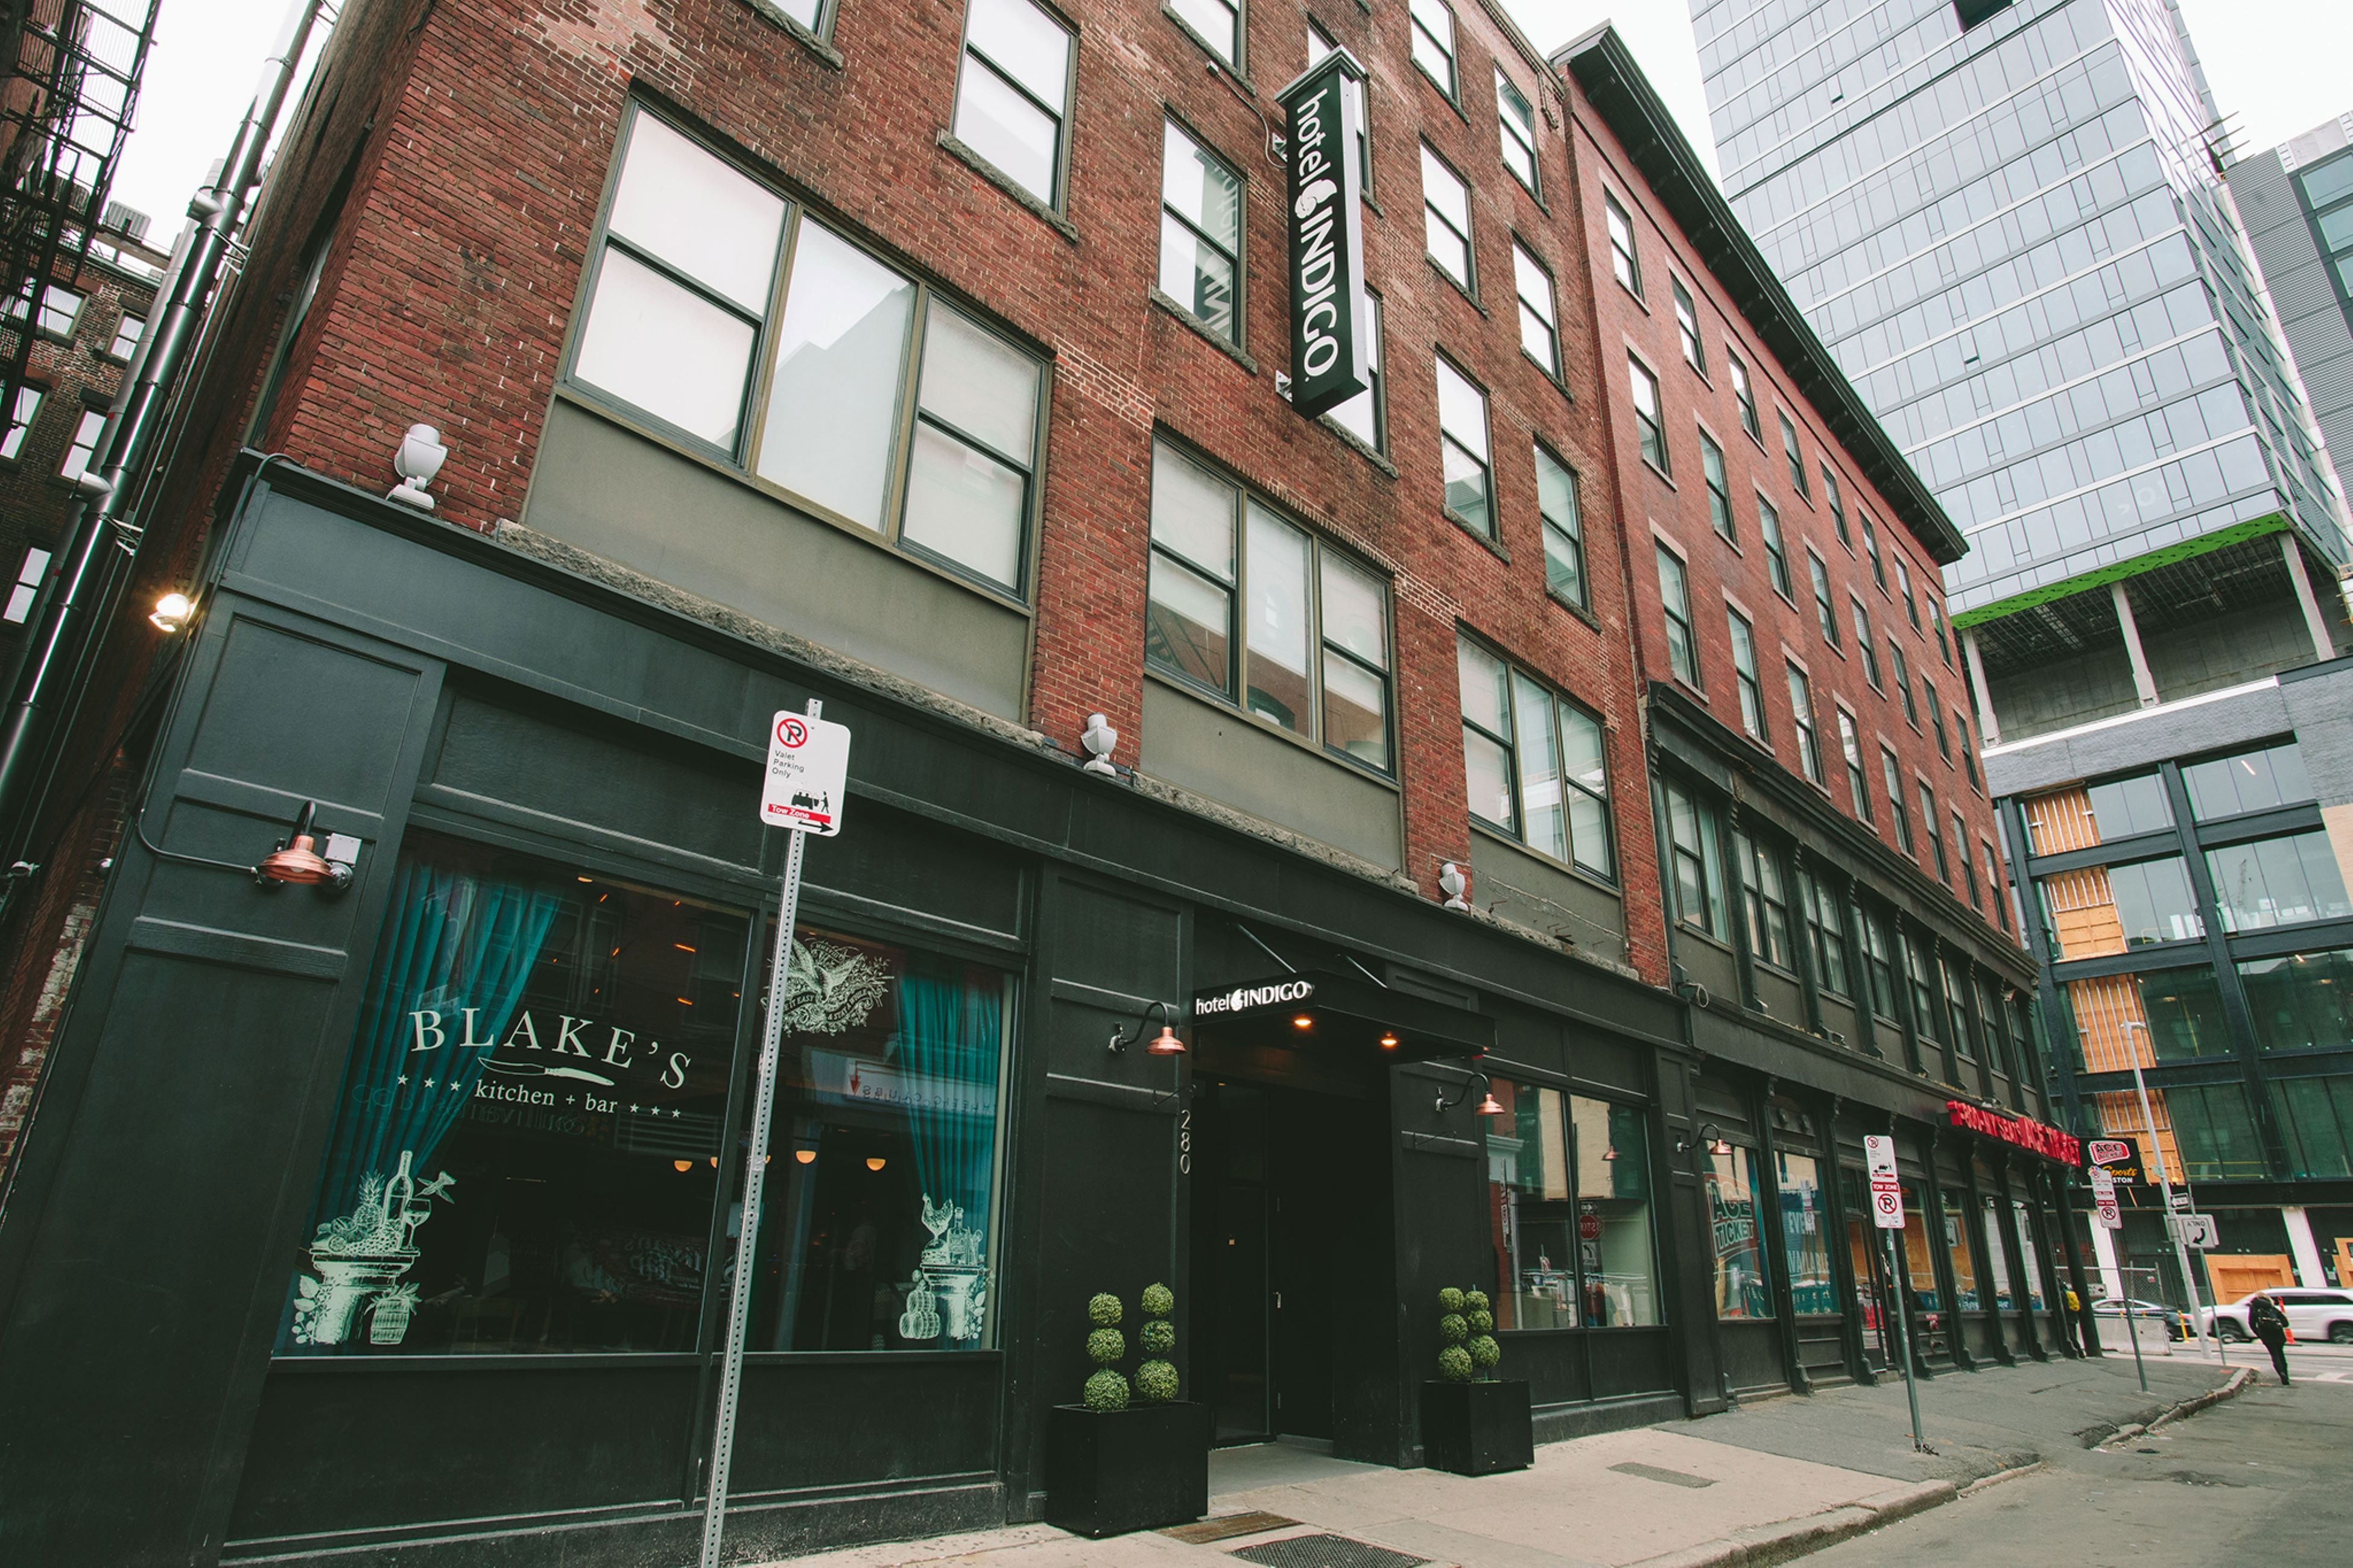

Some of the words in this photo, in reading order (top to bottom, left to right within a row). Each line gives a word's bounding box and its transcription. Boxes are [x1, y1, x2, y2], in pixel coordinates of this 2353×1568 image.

[1297, 88, 1331, 186] hotel
[1300, 206, 1338, 378] INDIGO
[773, 759, 805, 773] Parking
[774, 750, 796, 760] Valet
[771, 768, 791, 778] Only
[771, 805, 788, 815] Tow
[790, 808, 810, 819] Zone
[1196, 993, 1229, 1015] hotel
[1243, 981, 1310, 1008] INDIGO
[408, 1007, 691, 1089] BLAKE'S
[474, 1080, 555, 1106] kitchen
[584, 1090, 618, 1114] bar
[1180, 1109, 1191, 1174] 280
[2096, 1143, 2121, 1152] ACE
[1709, 1179, 1753, 1222] ACE
[1713, 1219, 1754, 1250] TICKET
